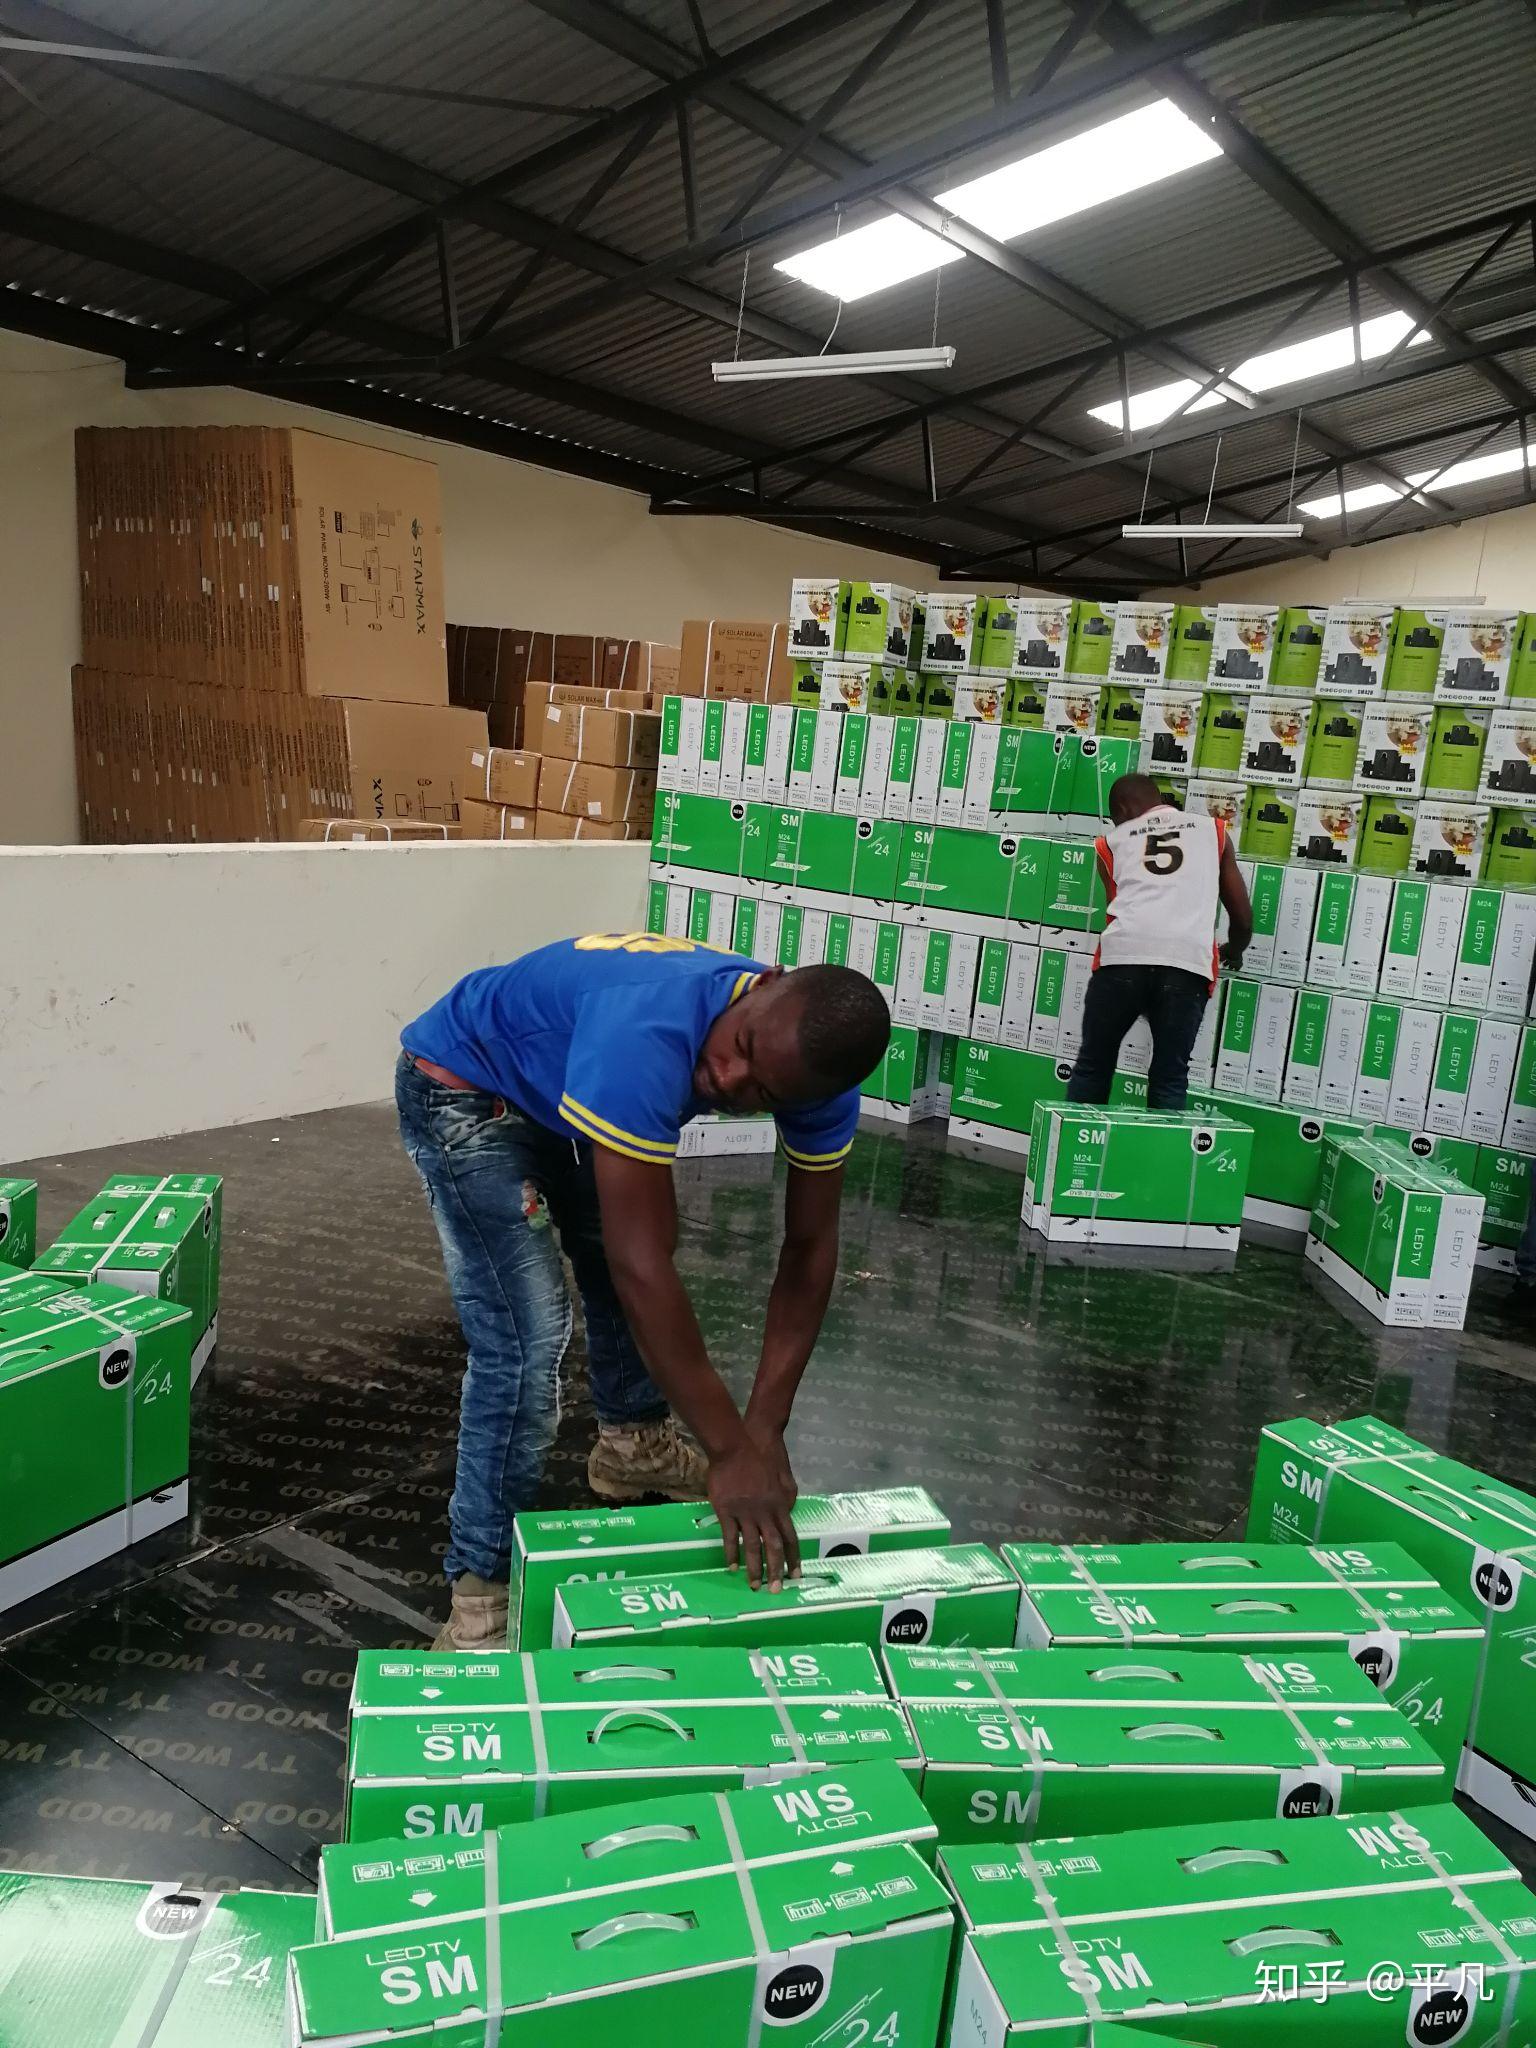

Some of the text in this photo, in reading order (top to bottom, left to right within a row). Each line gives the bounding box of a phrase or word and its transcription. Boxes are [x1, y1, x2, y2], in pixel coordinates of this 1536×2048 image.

[1101, 761, 1116, 773] 24
[781, 814, 798, 827] SM
[747, 825, 760, 837] 24
[914, 831, 934, 844] SM
[874, 844, 890, 856] 24
[1063, 851, 1084, 864] SM
[1144, 832, 1183, 875] 5
[1020, 862, 1037, 875] 24
[1059, 872, 1073, 880] M24
[891, 1048, 905, 1061] 24
[969, 1047, 989, 1062] SM
[966, 1067, 979, 1075] M24
[1124, 1081, 1147, 1097] SM
[1078, 1129, 1105, 1144] SM
[1074, 1154, 1091, 1162] M24
[1217, 1158, 1237, 1172] 24
[1496, 1158, 1525, 1176] SM
[1490, 1181, 1509, 1192] M24
[1415, 1205, 1432, 1213] M24
[12, 1233, 27, 1258] 24
[107, 1359, 130, 1375] NEW
[143, 1372, 173, 1404] 24
[1280, 1460, 1323, 1503] SM
[1273, 1502, 1299, 1528] M24
[620, 1591, 688, 1615] SM
[1089, 1605, 1157, 1625] SM
[185, 1617, 297, 1642] WOOD
[890, 1622, 923, 1638] NEW
[749, 1655, 821, 1678] SM
[1243, 1663, 1316, 1684] SM
[208, 1701, 329, 1729] WOOD
[1403, 1698, 1443, 1727] 24
[423, 1734, 501, 1762] SM
[977, 1725, 1054, 1751] SM
[242, 1752, 298, 1774] TY
[772, 1783, 855, 1823] SM
[968, 1790, 1042, 1824] SM
[403, 1803, 484, 1840] SM
[1347, 1824, 1431, 1856] SM
[152, 1905, 199, 1921] NEW
[204, 1953, 272, 1989] 24
[380, 1954, 479, 2005] SM
[1060, 1953, 1153, 1994] SM
[770, 1980, 818, 2003] NEW
[1420, 2008, 1462, 2027] NEW
[843, 2010, 900, 2048] 24
